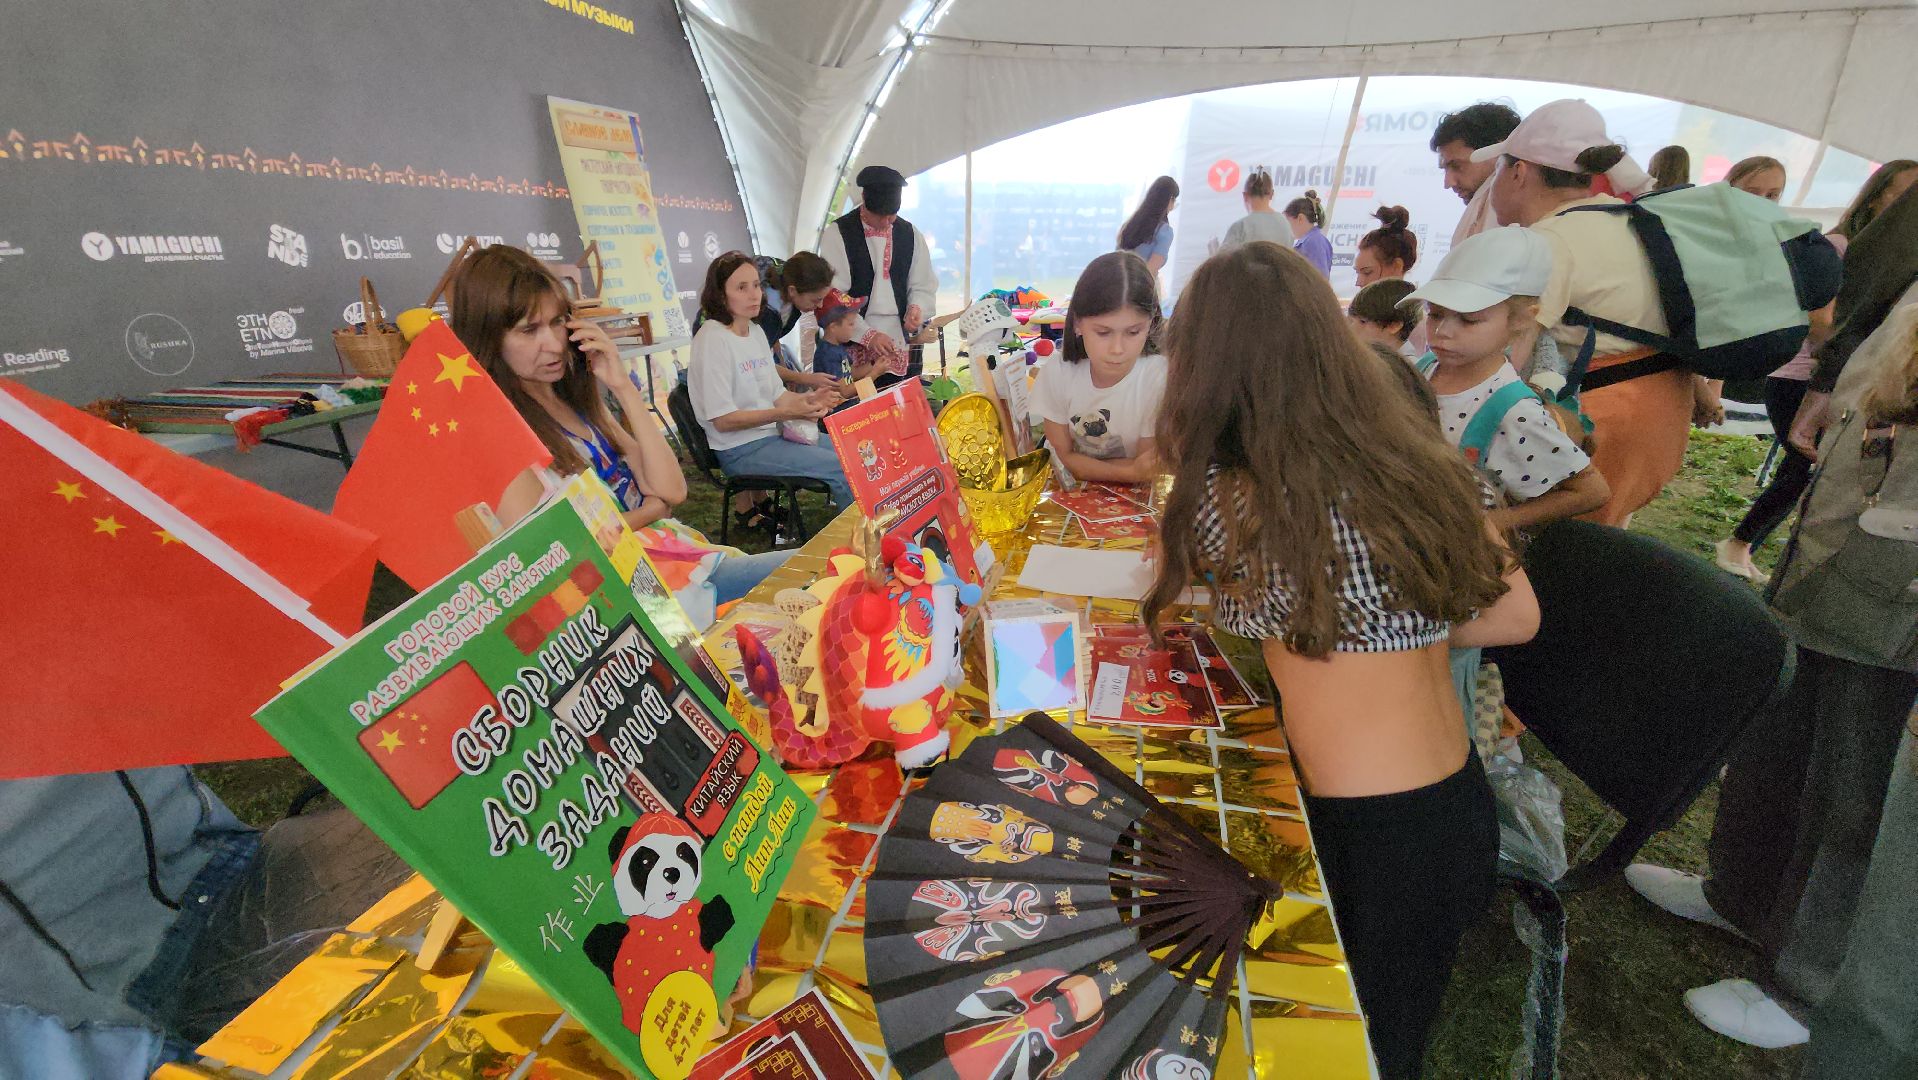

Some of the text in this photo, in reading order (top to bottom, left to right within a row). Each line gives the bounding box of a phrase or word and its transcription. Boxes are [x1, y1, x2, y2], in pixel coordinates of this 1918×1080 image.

[572, 0, 634, 34] МУЗЫКИ
[1248, 165, 1376, 187] MAGUCHI
[115, 235, 223, 255] YAMAGUCHI
[370, 235, 405, 251] basil
[3, 348, 71, 365] Reading
[350, 599, 501, 724] РАЗВИВАЮЩИХ
[497, 541, 570, 607] ЗАНЯТИЙ
[385, 553, 523, 662] ГОДОВОЙ КУРС
[452, 605, 608, 775] СБОРНИК
[482, 635, 657, 856] ДОМАШНИХ
[537, 684, 671, 869] ЗАДАНИЙ
[690, 738, 743, 817] КИТАЙСКИЙ
[716, 774, 743, 808] ЯЗЫК
[731, 772, 773, 847] пандой
[744, 796, 796, 893] Лин Лин
[539, 874, 604, 952] 作业
[654, 997, 676, 1033] Для
[665, 1000, 692, 1052] детей
[690, 1008, 706, 1037] лет
